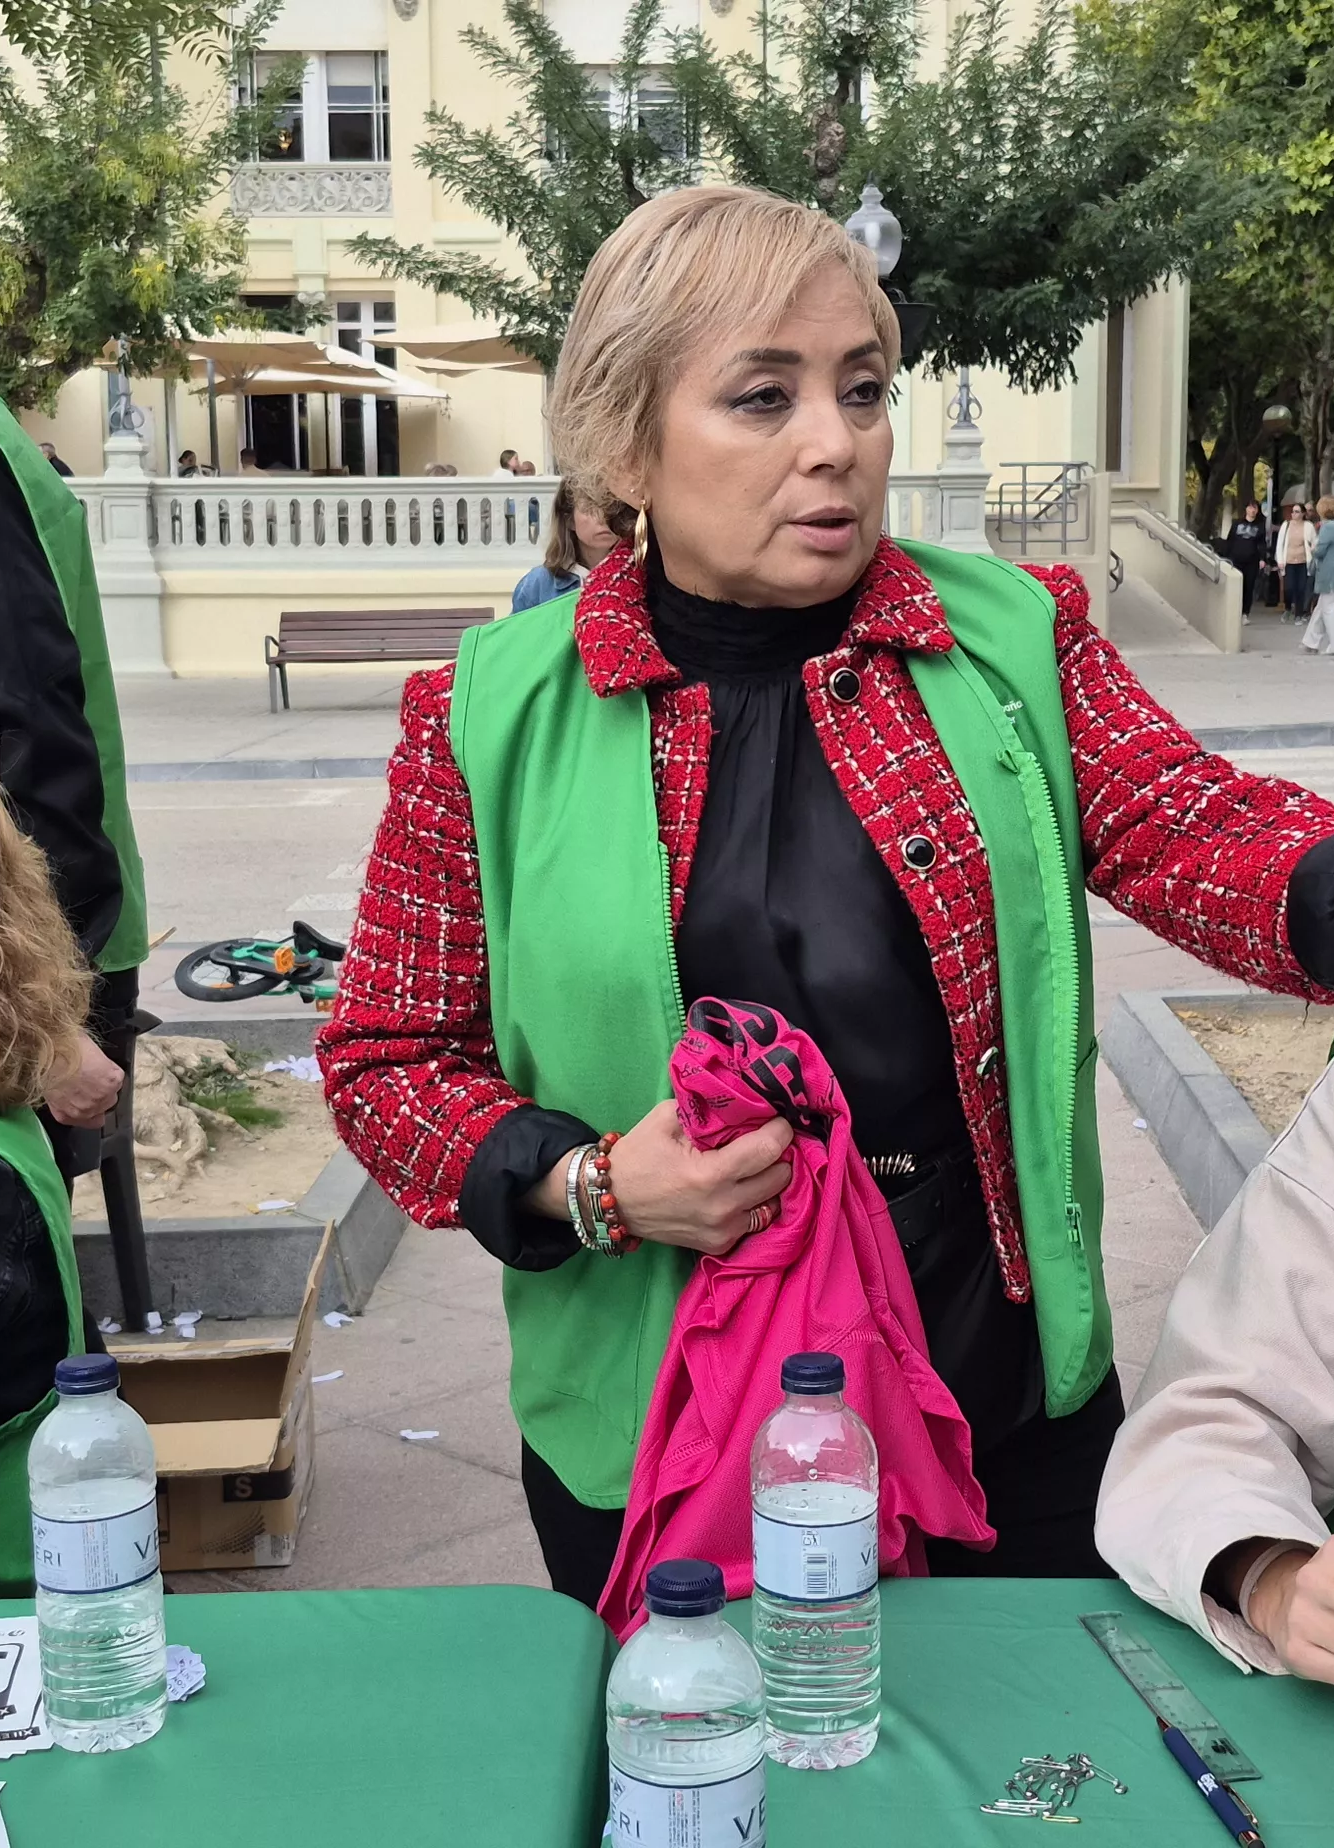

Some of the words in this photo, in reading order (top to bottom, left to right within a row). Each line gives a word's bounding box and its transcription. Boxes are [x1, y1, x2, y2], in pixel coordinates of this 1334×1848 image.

[235, 1476, 253, 1498] S
[35, 1549, 63, 1569] ERI
[860, 1542, 878, 1567] VE
[611, 1807, 641, 1840] ERI
[733, 1794, 766, 1842] VE
